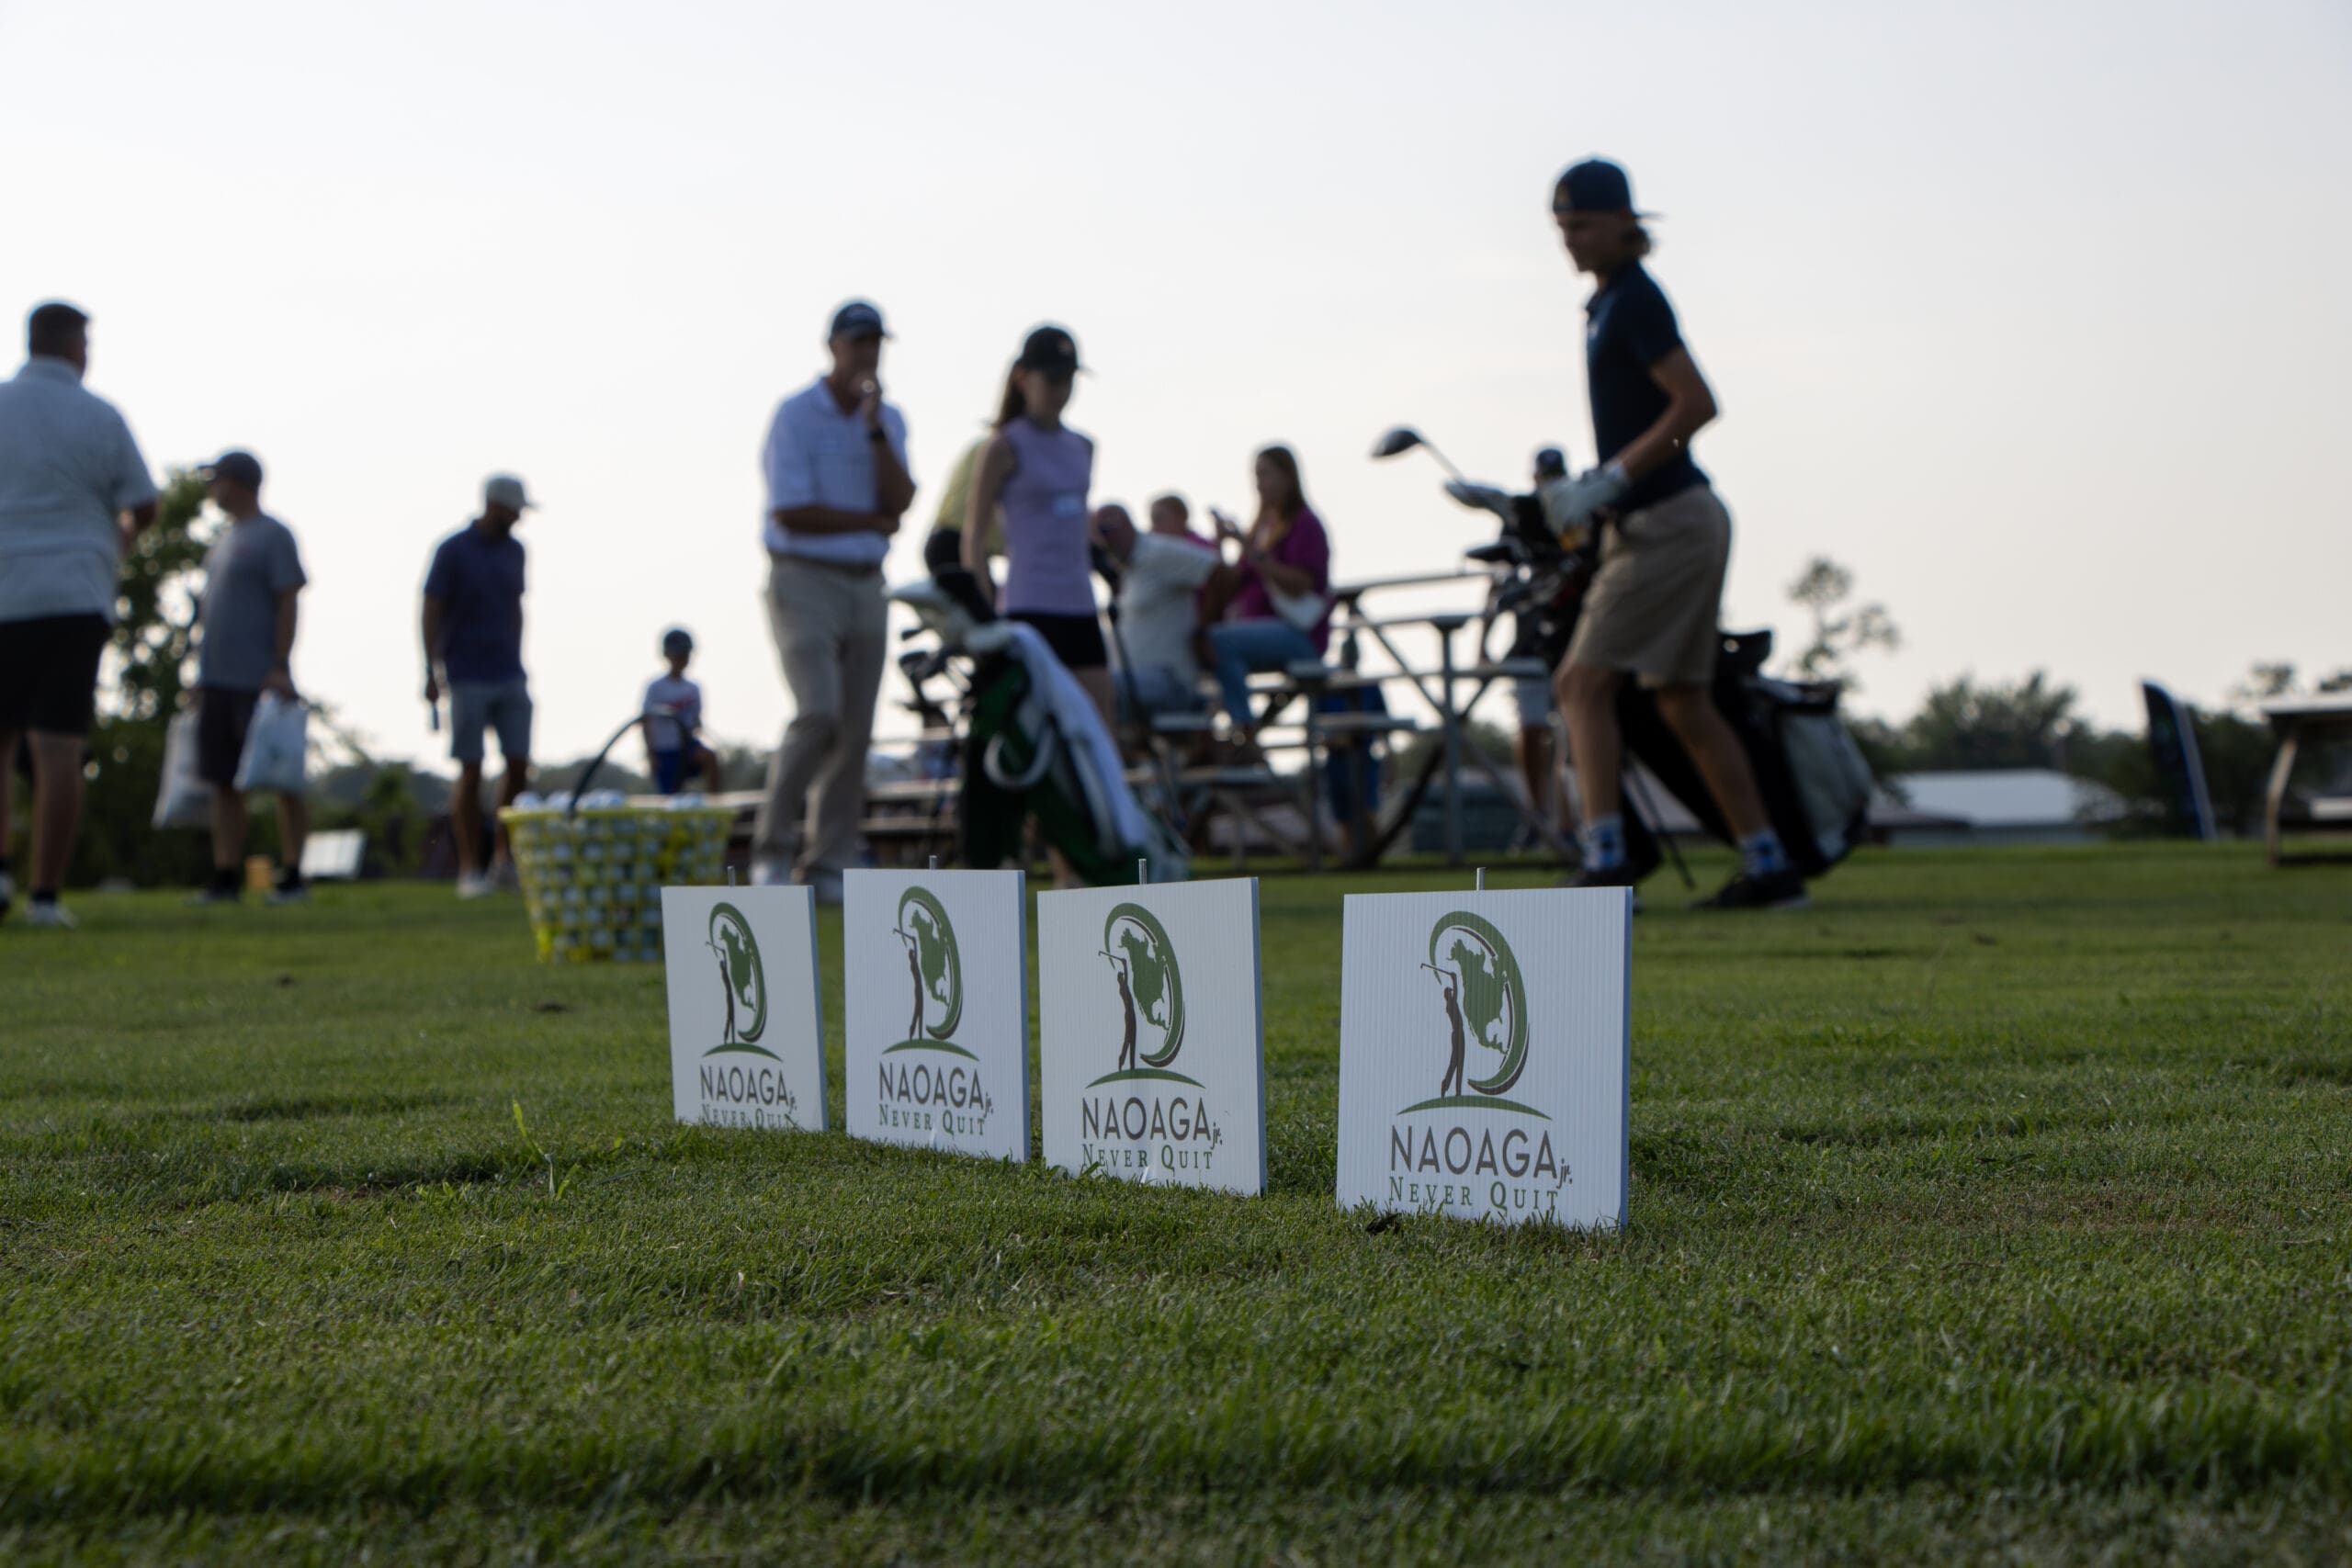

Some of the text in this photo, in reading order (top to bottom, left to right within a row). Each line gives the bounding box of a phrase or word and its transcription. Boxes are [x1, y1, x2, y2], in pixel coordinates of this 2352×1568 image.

[699, 1065, 789, 1106] NAOAGA
[879, 1061, 984, 1110] NAOAGA
[878, 1103, 986, 1136] NEVER QUIT
[1081, 1096, 1212, 1141] NAOAGA
[1081, 1143, 1214, 1172] NEVER QUIT
[1390, 1124, 1558, 1179] NAOAGA
[1388, 1176, 1559, 1215] NEVER QUIT
